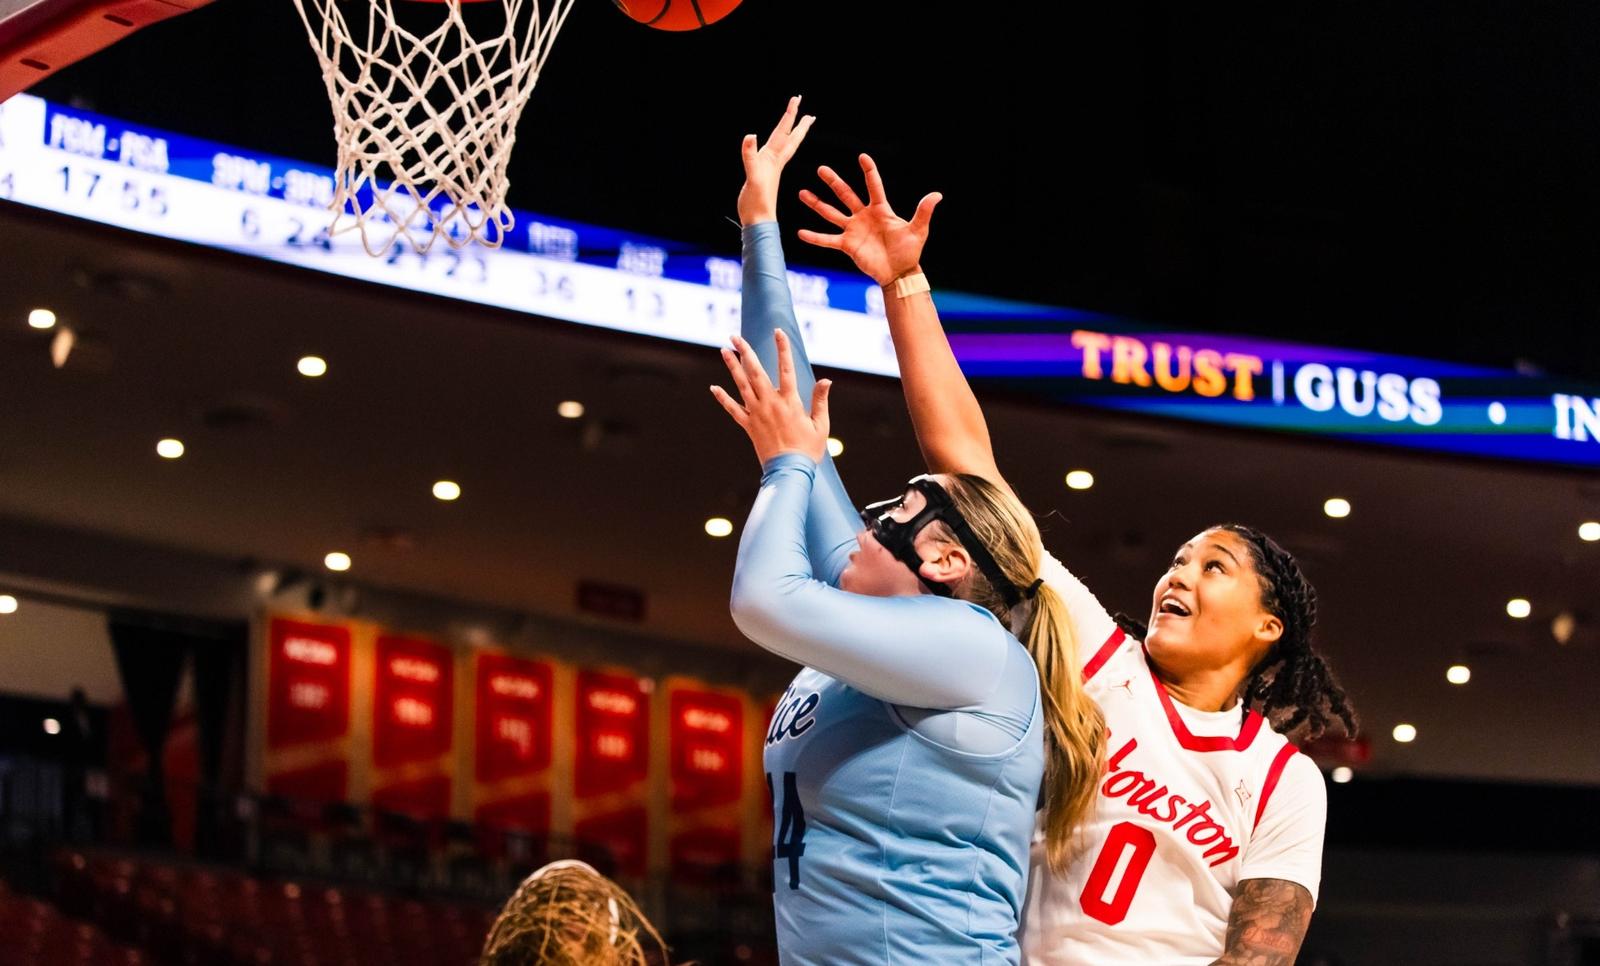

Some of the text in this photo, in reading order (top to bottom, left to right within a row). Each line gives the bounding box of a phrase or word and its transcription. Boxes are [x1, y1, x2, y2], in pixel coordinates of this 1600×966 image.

[60, 165, 101, 199] 17
[241, 207, 260, 241] 6
[1071, 330, 1442, 426] TRUST GUSS
[766, 682, 820, 746] ice
[766, 771, 807, 890] 4
[1079, 821, 1157, 926] 0
